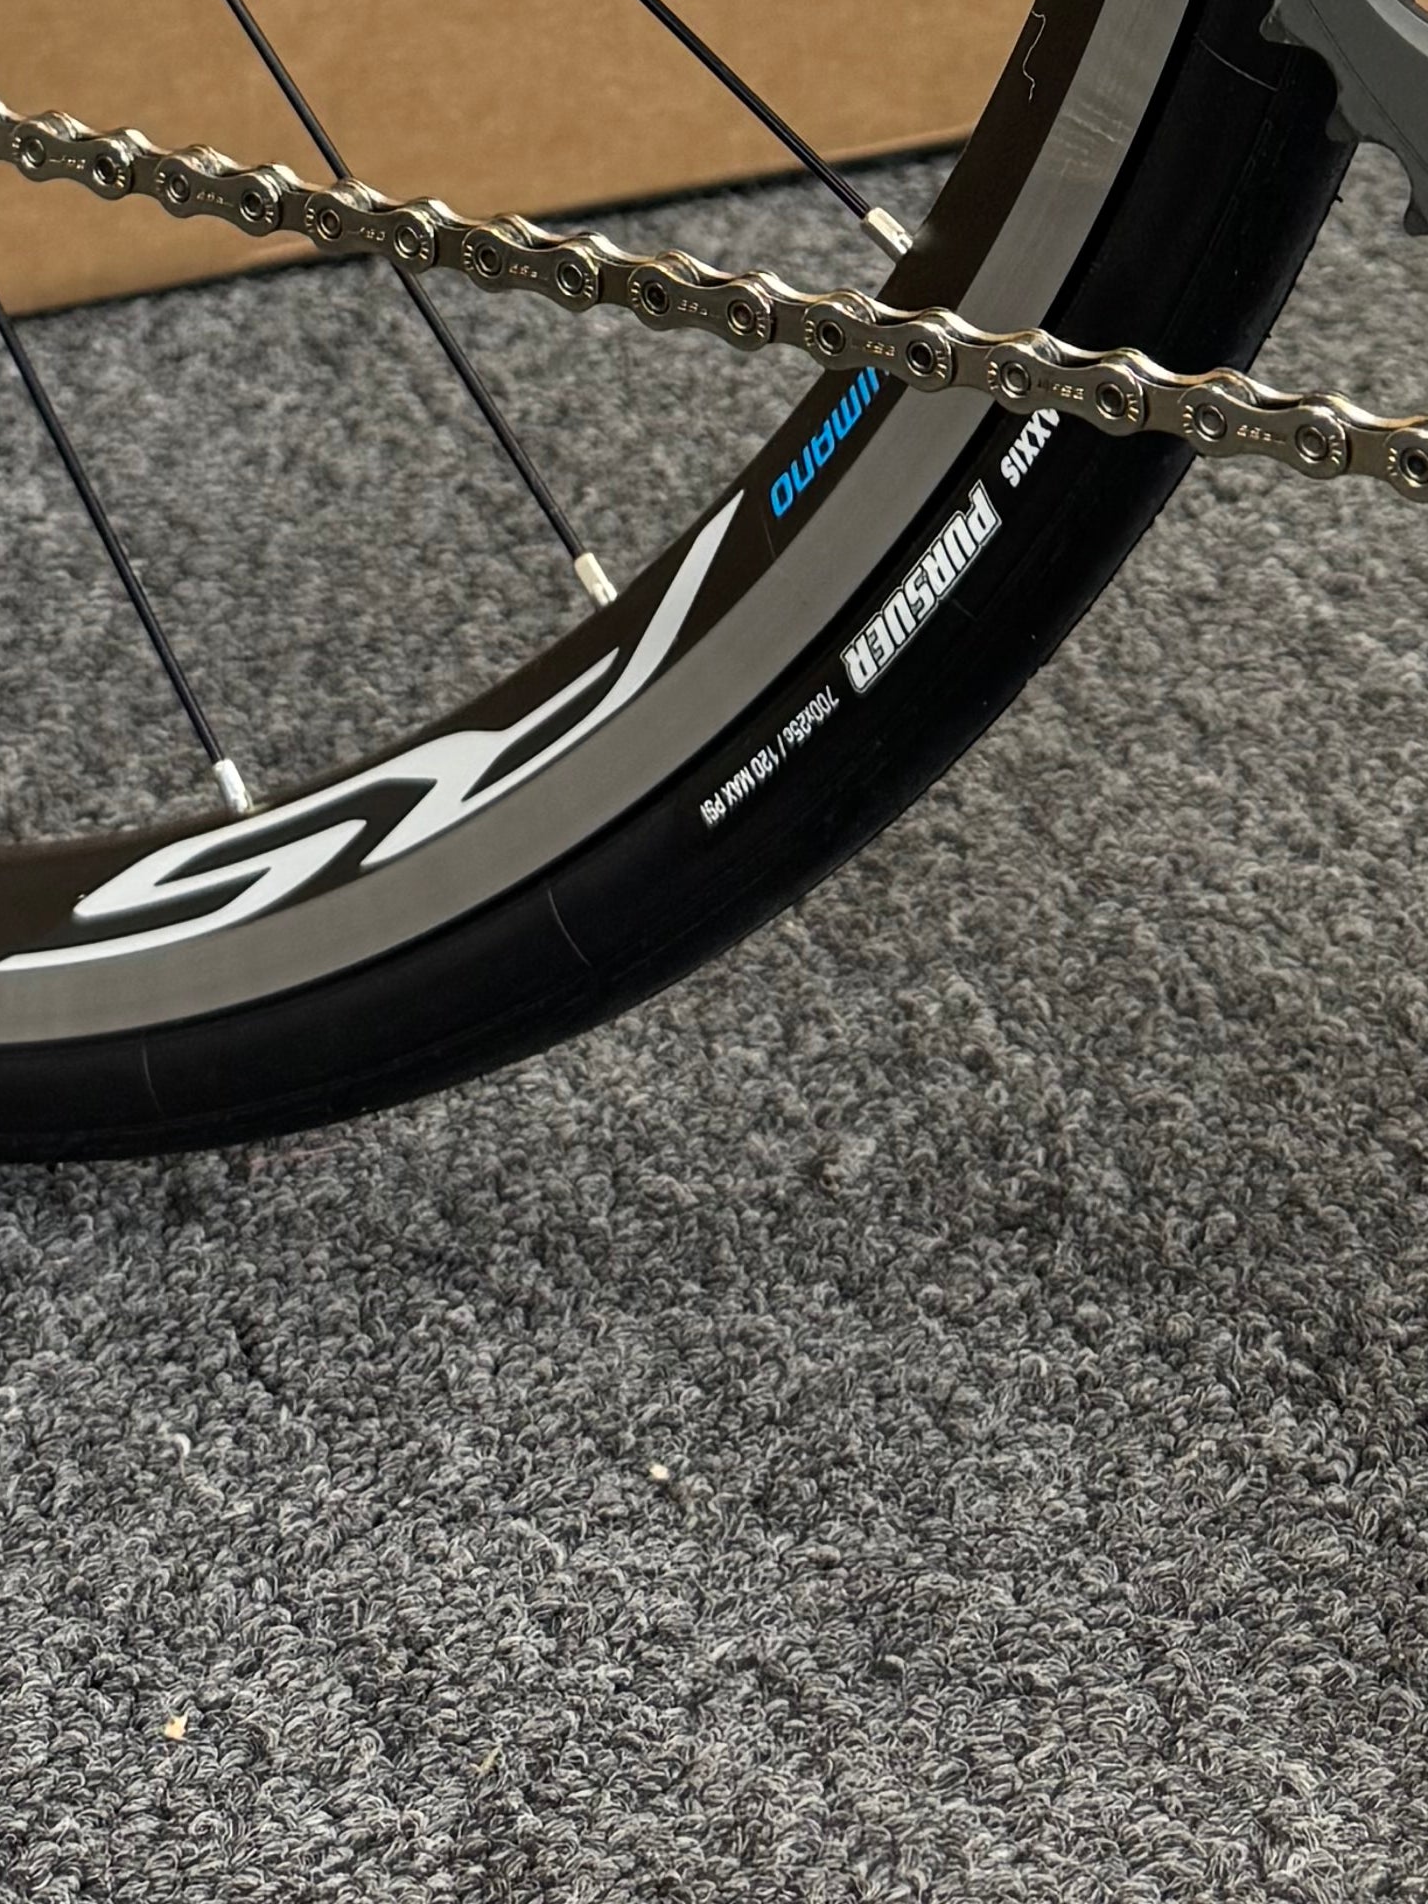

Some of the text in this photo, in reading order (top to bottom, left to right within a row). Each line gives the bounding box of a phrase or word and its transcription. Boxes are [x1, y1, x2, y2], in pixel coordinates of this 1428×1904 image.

[839, 478, 1003, 694] PURSUER
[750, 744, 780, 780] 120
[720, 765, 756, 806] MAX
[699, 791, 727, 826] PSI
